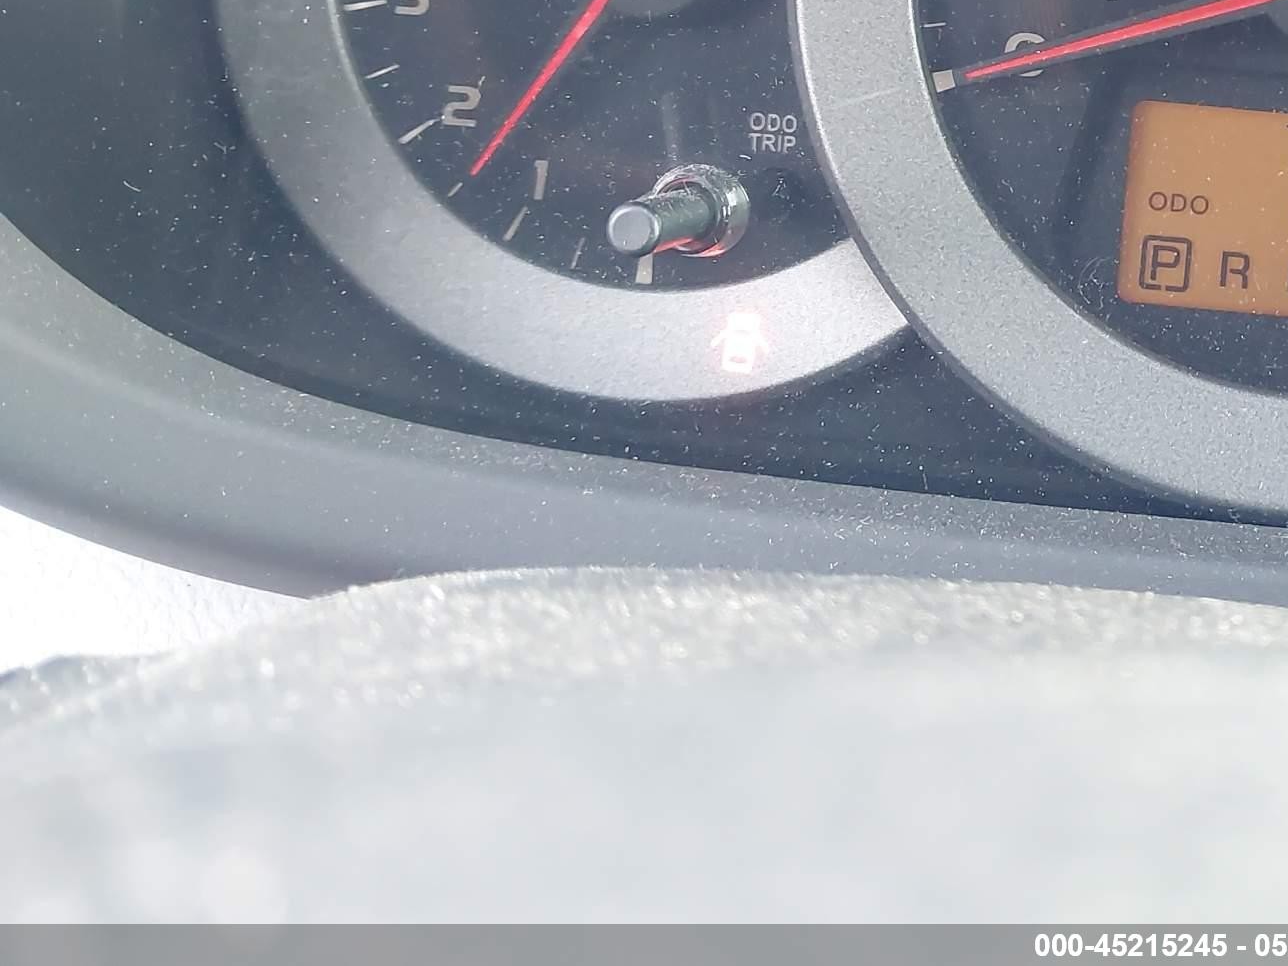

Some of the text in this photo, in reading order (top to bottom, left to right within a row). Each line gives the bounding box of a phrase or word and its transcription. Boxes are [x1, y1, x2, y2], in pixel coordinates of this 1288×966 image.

[441, 86, 481, 127] 2
[750, 113, 797, 132] ODO
[749, 133, 795, 153] TRIP
[534, 160, 548, 199] 1
[1149, 192, 1209, 214] ODO
[1150, 245, 1180, 280] P
[1220, 251, 1250, 289] R
